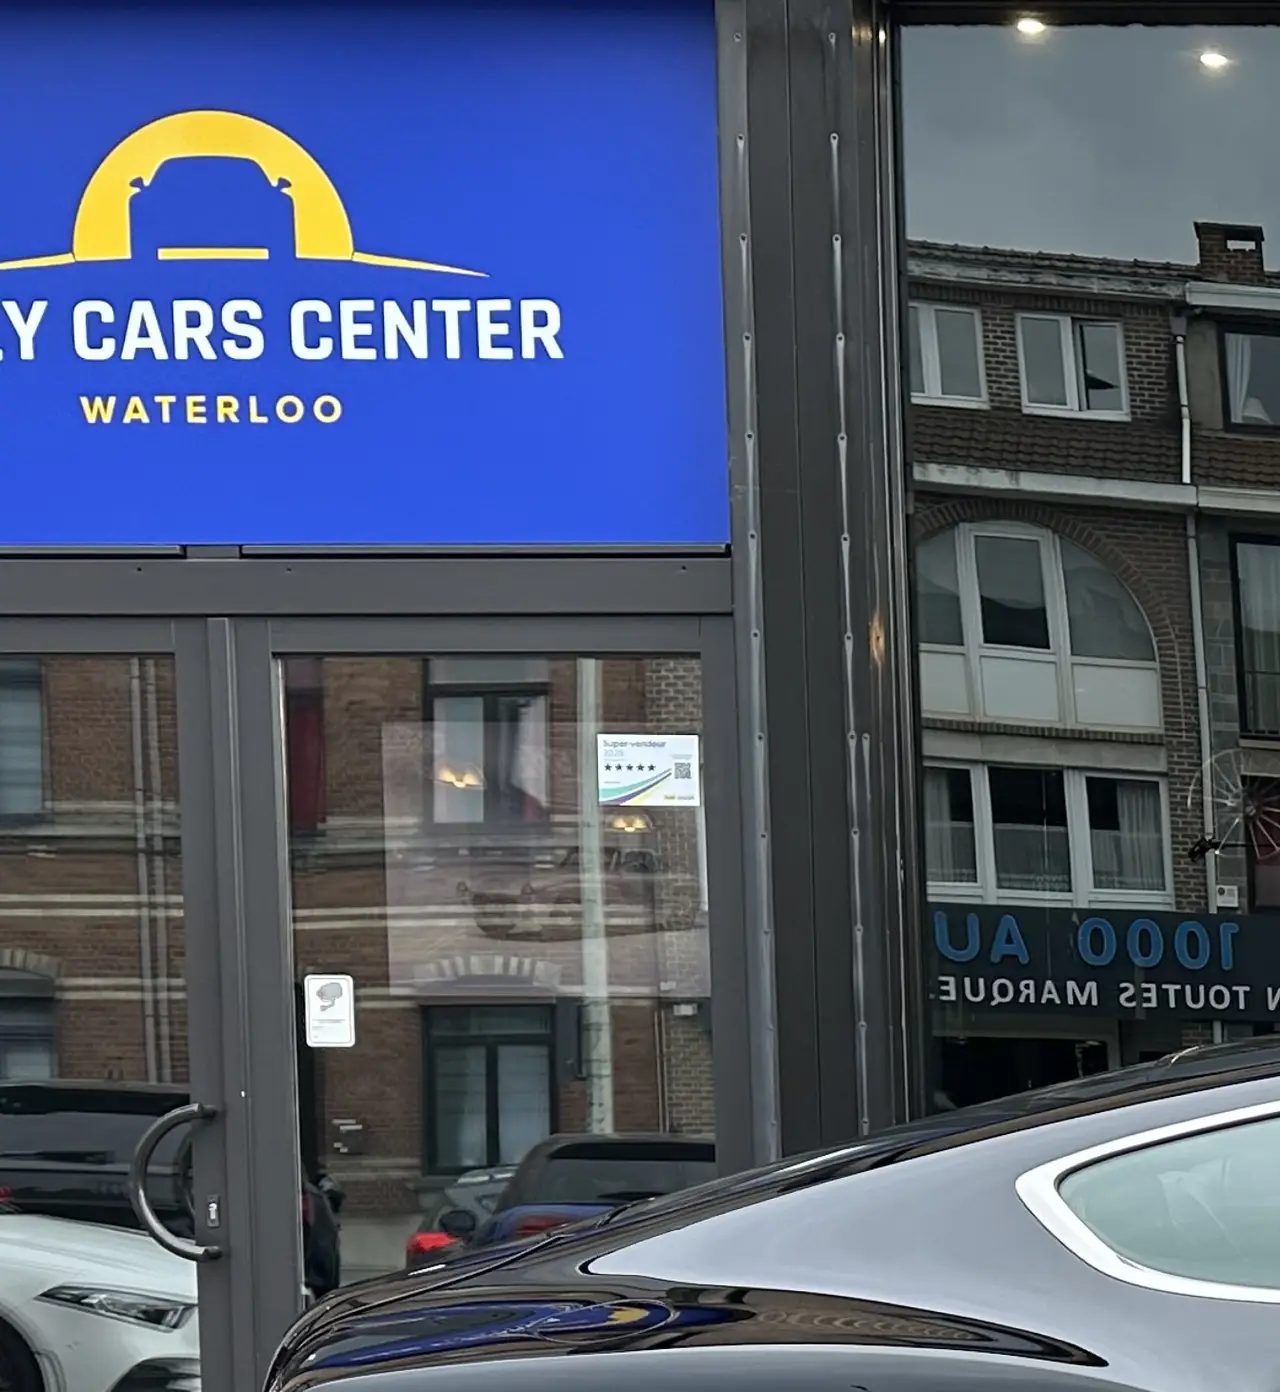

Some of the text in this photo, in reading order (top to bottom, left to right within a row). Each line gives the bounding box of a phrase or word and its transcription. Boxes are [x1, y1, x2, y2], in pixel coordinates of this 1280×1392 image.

[0, 298, 564, 361] Y CARS CENTER
[80, 395, 342, 424] WATERLOO
